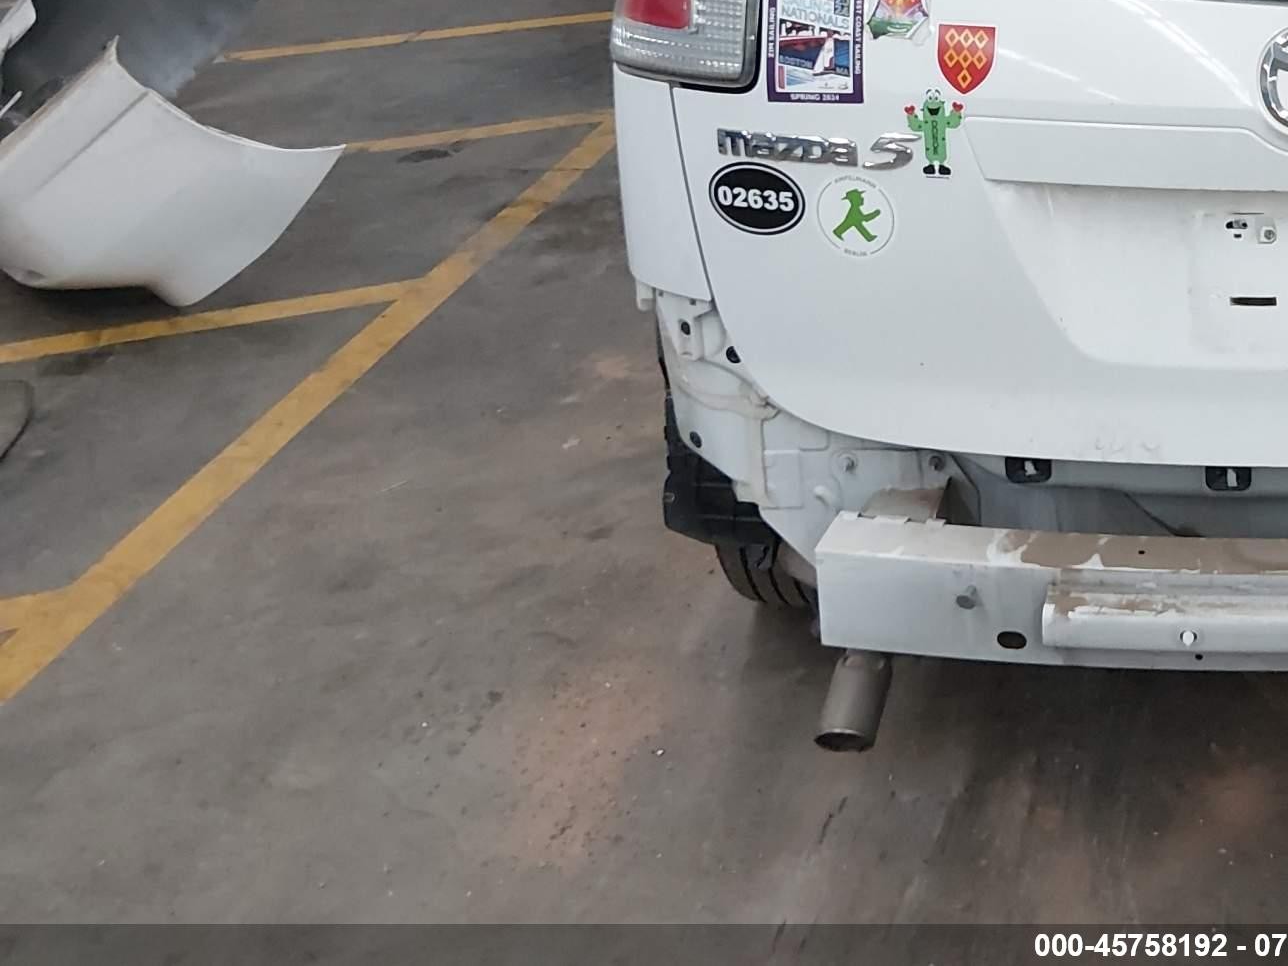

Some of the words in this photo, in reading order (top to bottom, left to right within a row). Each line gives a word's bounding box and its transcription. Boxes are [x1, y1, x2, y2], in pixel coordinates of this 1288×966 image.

[782, 6, 850, 30] NATIONALS
[854, 44, 862, 75] SAILING
[862, 132, 922, 170] 5
[717, 185, 795, 212] 02635
